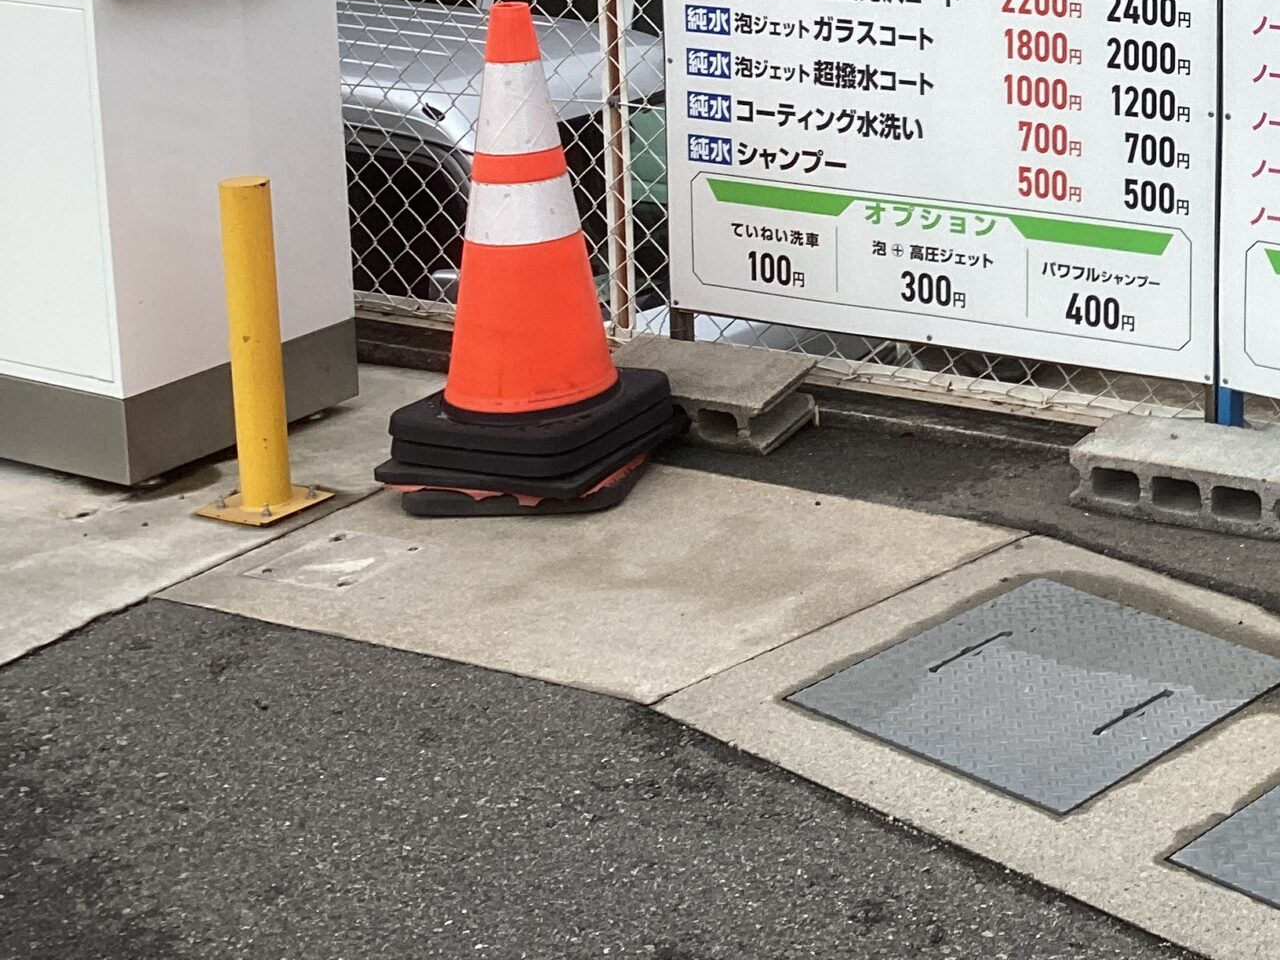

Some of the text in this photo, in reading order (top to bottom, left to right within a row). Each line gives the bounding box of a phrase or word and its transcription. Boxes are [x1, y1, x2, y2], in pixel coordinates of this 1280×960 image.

[686, 6, 729, 33] 純水
[687, 50, 730, 77] 純水
[1004, 28, 1082, 65] 1800円
[1107, 37, 1191, 75] 2000円
[1004, 74, 1082, 111] 1000円
[1111, 84, 1190, 122] 1200円
[687, 93, 923, 140] 純水 コーティング水洗い
[688, 136, 847, 173] 純水 シャンプー
[1018, 120, 1082, 157] 700円
[1124, 132, 1190, 169] 700円
[1018, 166, 1082, 202] 500円
[1124, 178, 1190, 215] 500円
[730, 222, 820, 247] ていねい洗車
[865, 202, 996, 236] オプション
[747, 250, 805, 287] 100円
[1042, 261, 1161, 287] パワフルシャンプー
[900, 270, 966, 308] 300円
[1065, 292, 1135, 331] 400円
